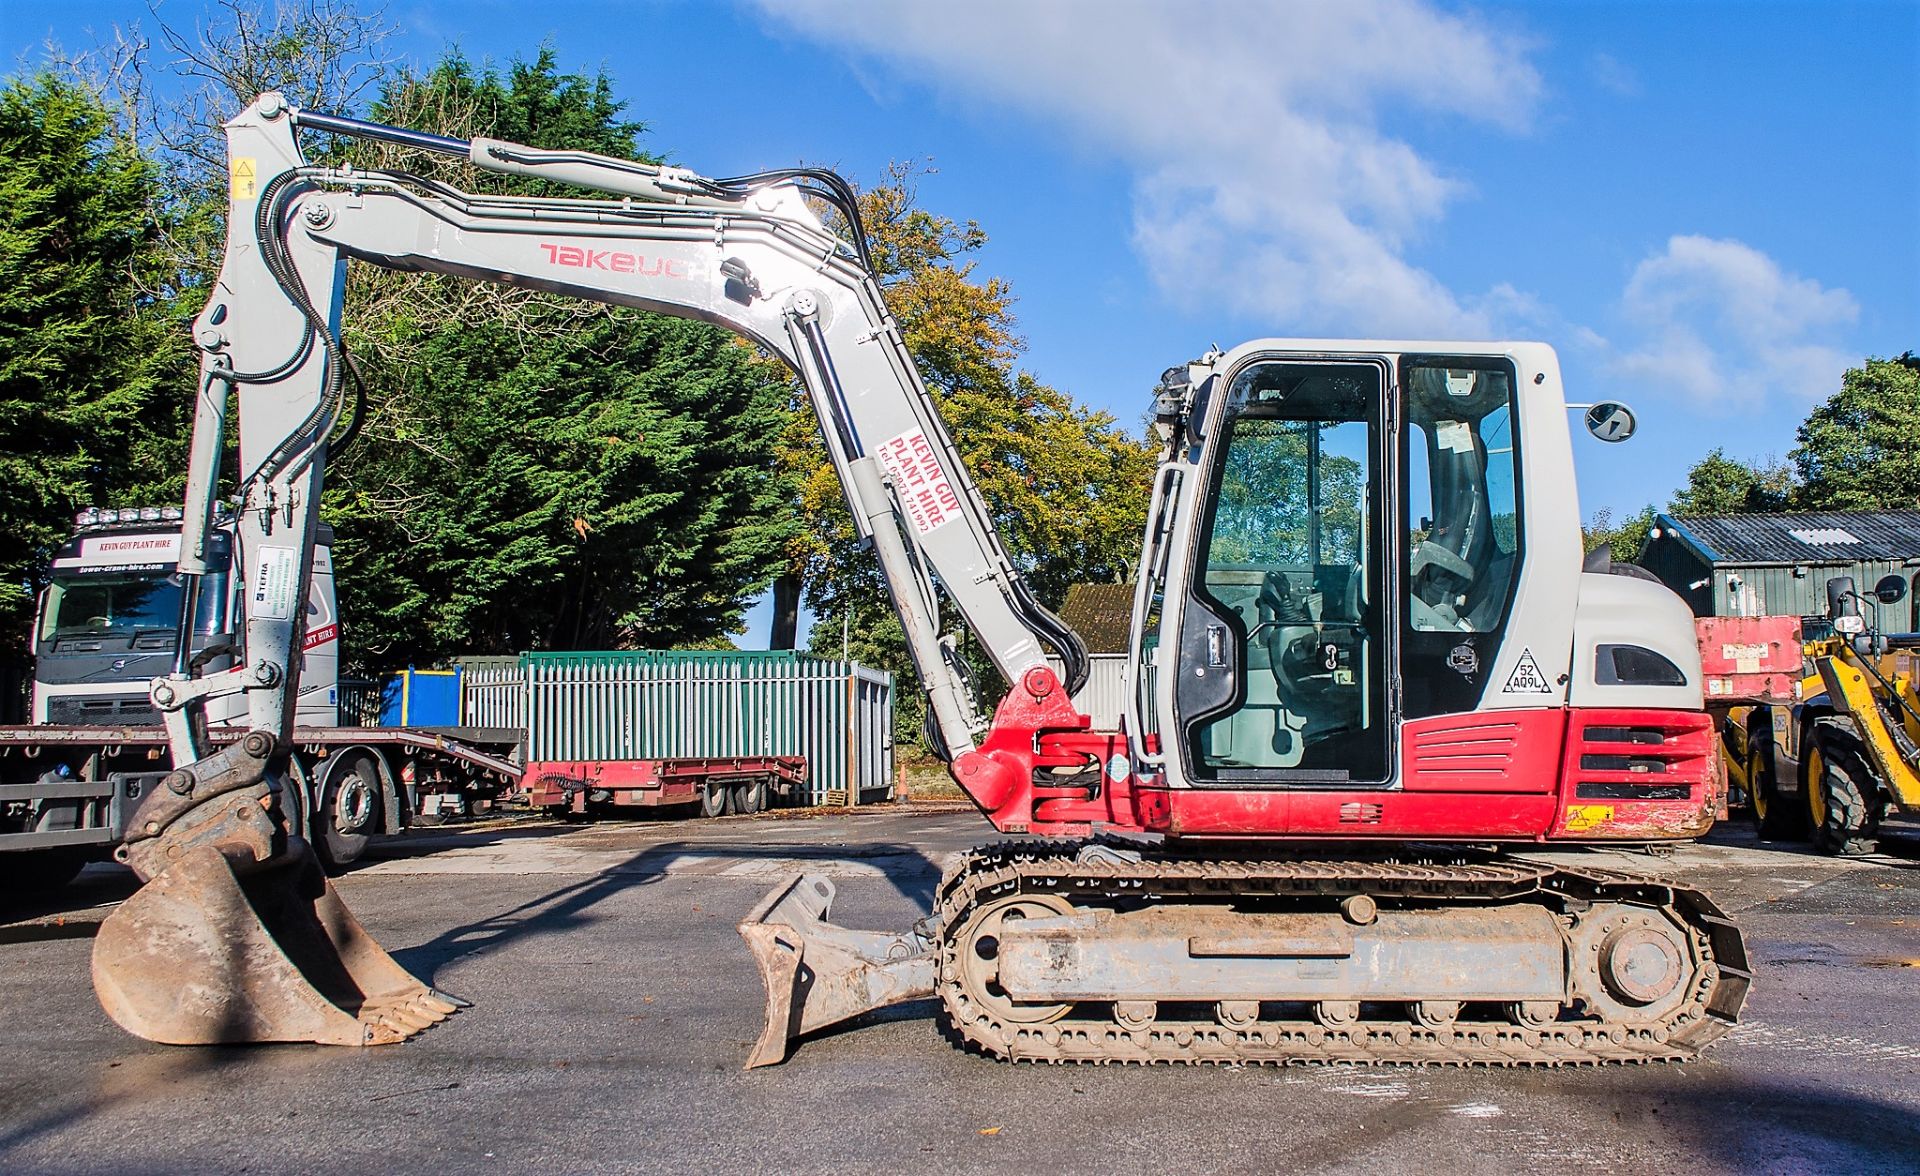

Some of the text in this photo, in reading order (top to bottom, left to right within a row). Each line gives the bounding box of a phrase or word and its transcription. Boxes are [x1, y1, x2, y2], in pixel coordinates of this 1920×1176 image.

[909, 434, 960, 512] KEVIN GUY
[890, 437, 946, 527] PLANT HIRE
[879, 446, 893, 465] Tel.
[906, 497, 929, 533] 741992
[99, 540, 172, 552] KEVIN GUY PLANT HIRE
[80, 563, 164, 574] tower-crane-hire.com
[259, 563, 268, 591] TEFRA
[318, 628, 334, 641] HIRE
[1520, 664, 1534, 676] 52
[1513, 677, 1541, 688] AQ9L
